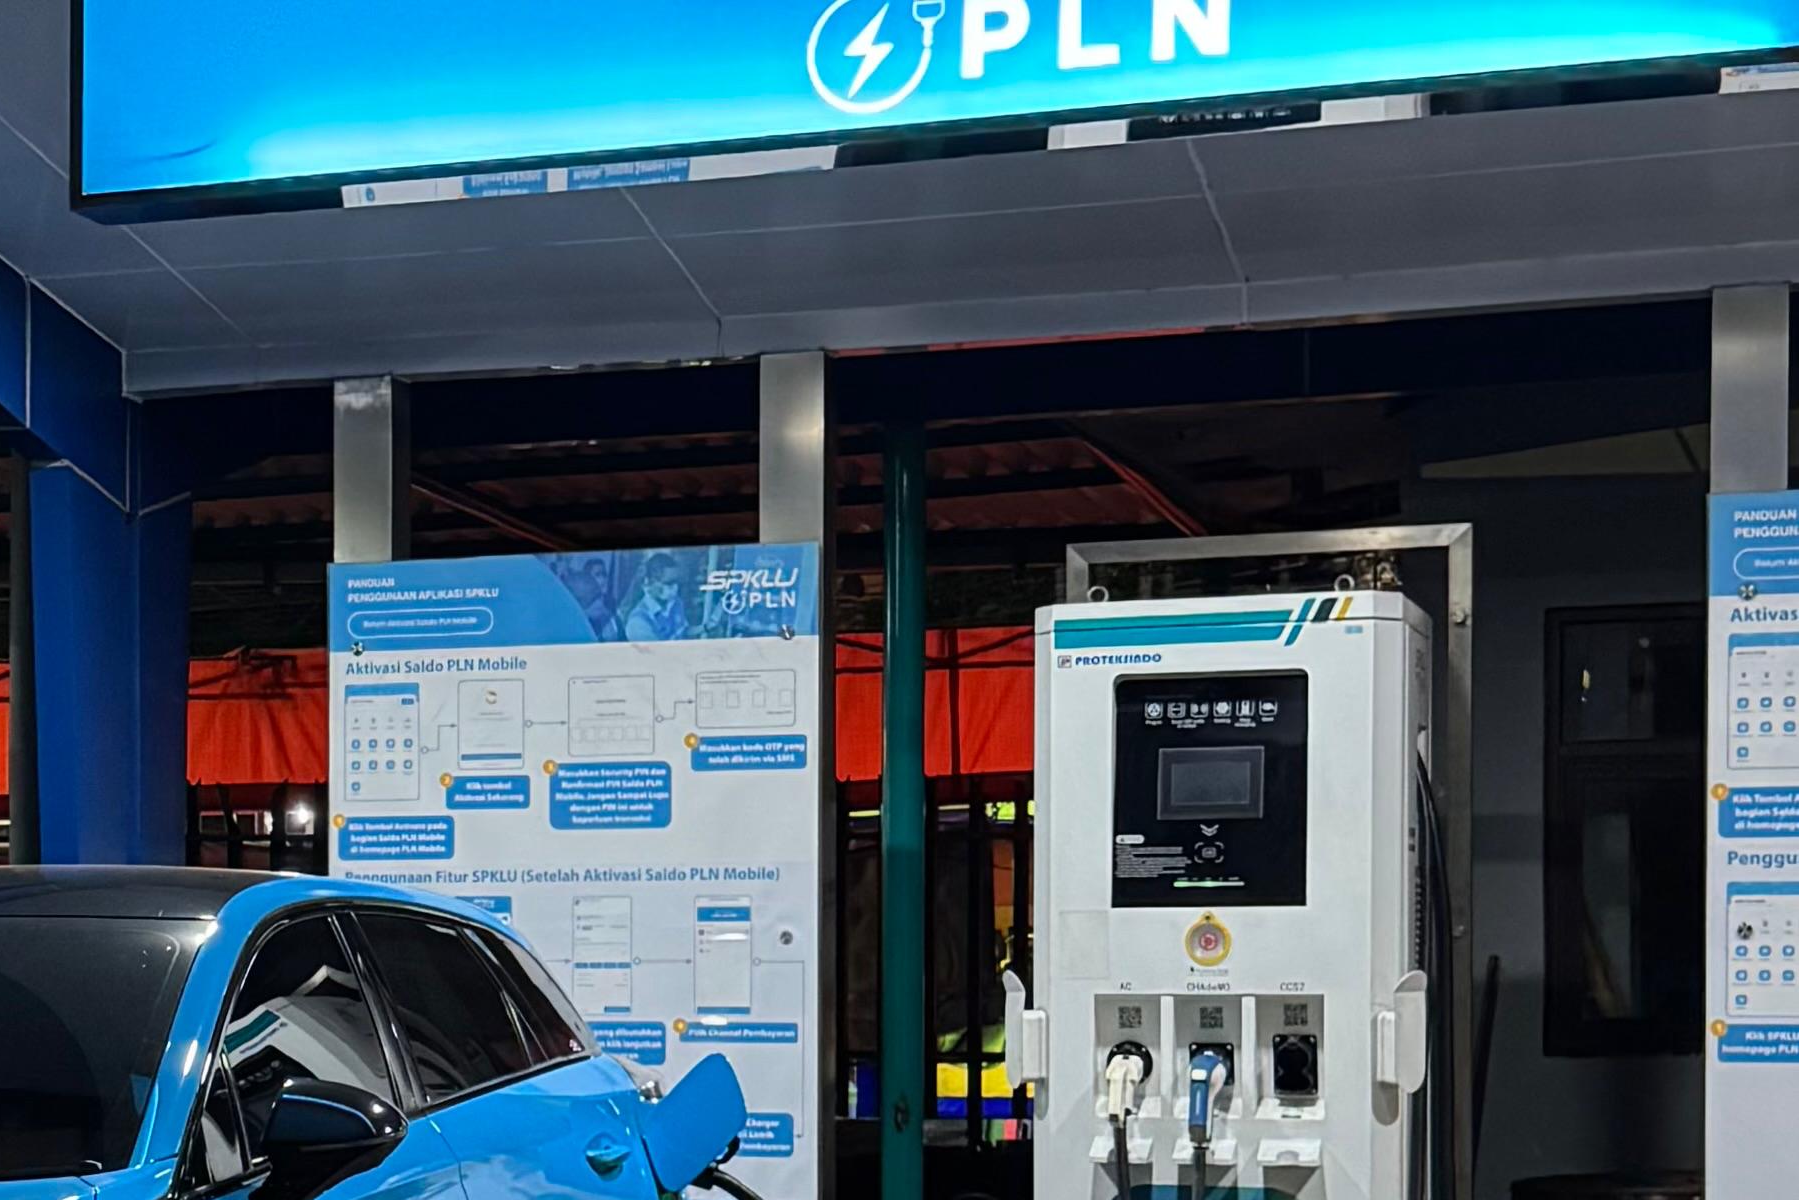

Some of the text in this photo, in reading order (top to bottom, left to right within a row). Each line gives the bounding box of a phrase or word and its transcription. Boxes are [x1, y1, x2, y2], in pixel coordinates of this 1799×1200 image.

[959, 0, 1233, 80] PLN
[1734, 509, 1797, 522] PANDUAN
[1734, 525, 1799, 538] PENGGUN
[347, 578, 395, 589] PANDUAN
[699, 567, 799, 591] SPKLU
[347, 588, 499, 603] PENGGUNAAN APLIKASI SPKLU
[749, 590, 797, 608] PLN
[1730, 607, 1799, 622] Aktivas
[345, 656, 528, 676] Aktivasi Saldo PLN Mobile
[1727, 851, 1799, 868] Penggu
[436, 870, 468, 883] Fitur
[472, 870, 517, 883] SPKLU
[521, 869, 579, 884] (Setelah
[583, 868, 642, 882] Aktivasi
[645, 867, 686, 881] Saldo
[690, 867, 719, 880] PLN
[723, 866, 780, 882] Mobile)
